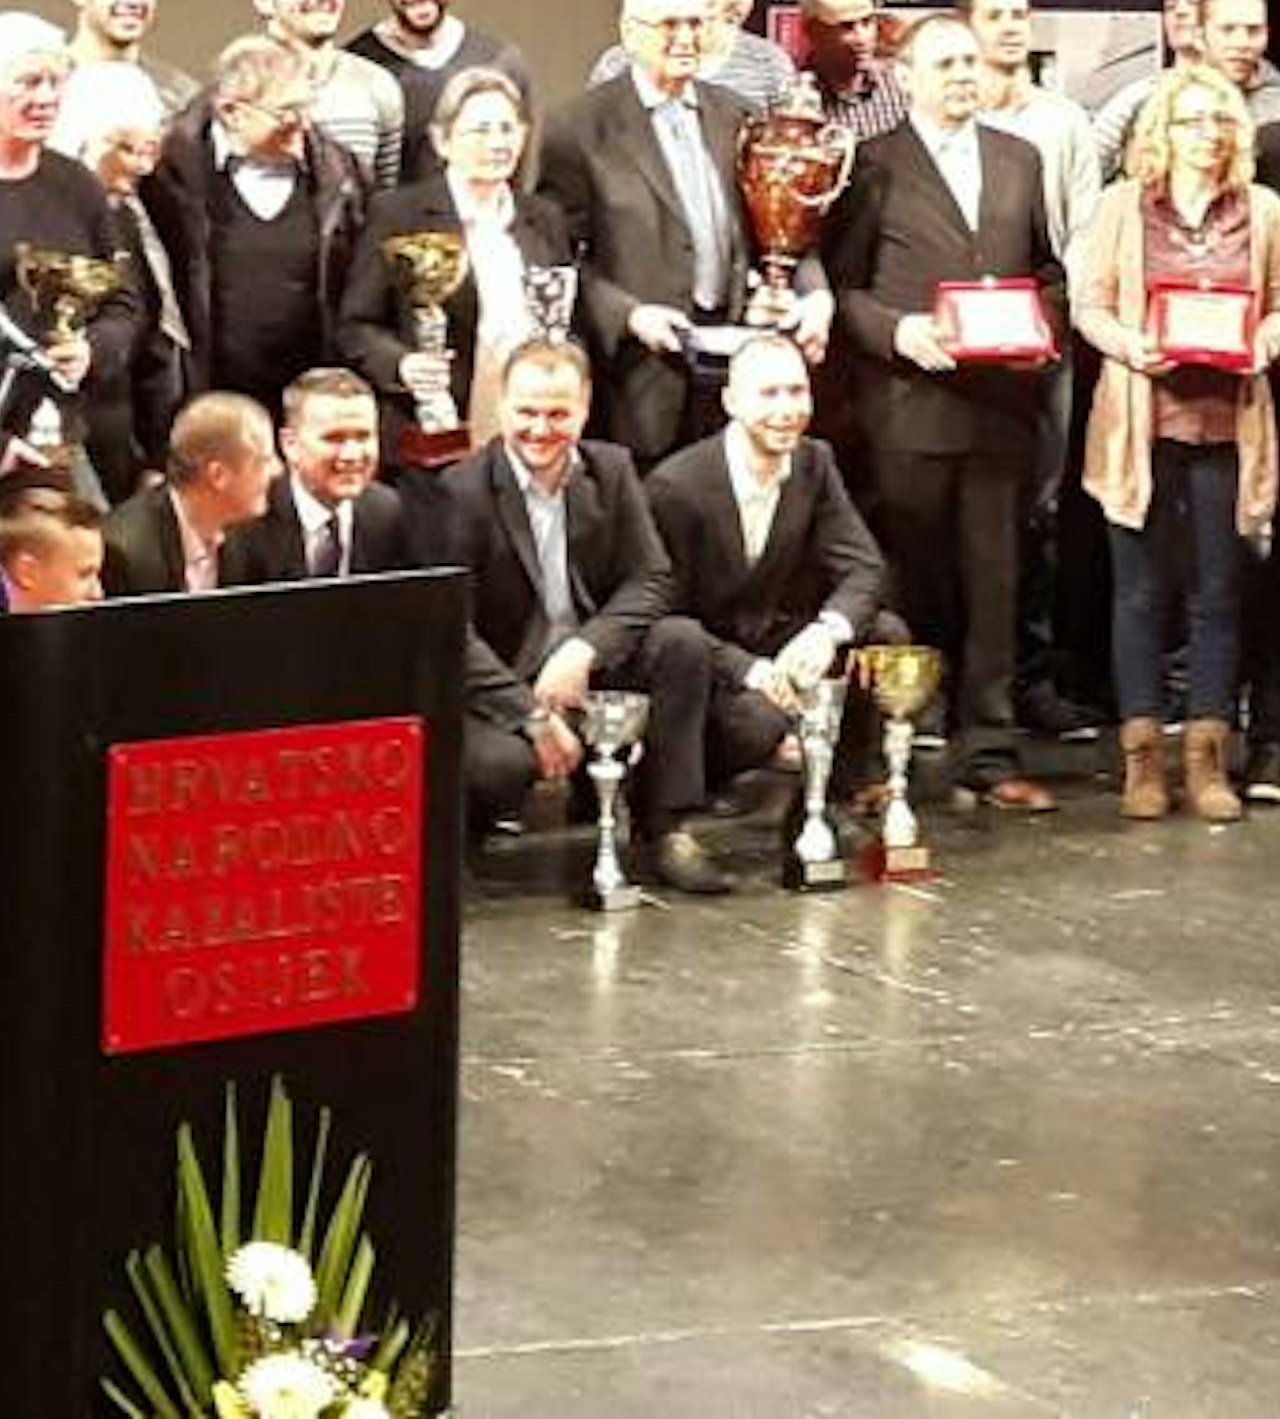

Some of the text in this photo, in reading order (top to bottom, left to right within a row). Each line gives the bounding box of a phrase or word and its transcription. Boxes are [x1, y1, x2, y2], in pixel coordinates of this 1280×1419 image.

[126, 738, 410, 817] HRVATSKO
[126, 805, 408, 884] NARODNO
[163, 943, 371, 1018] OSIJEK
